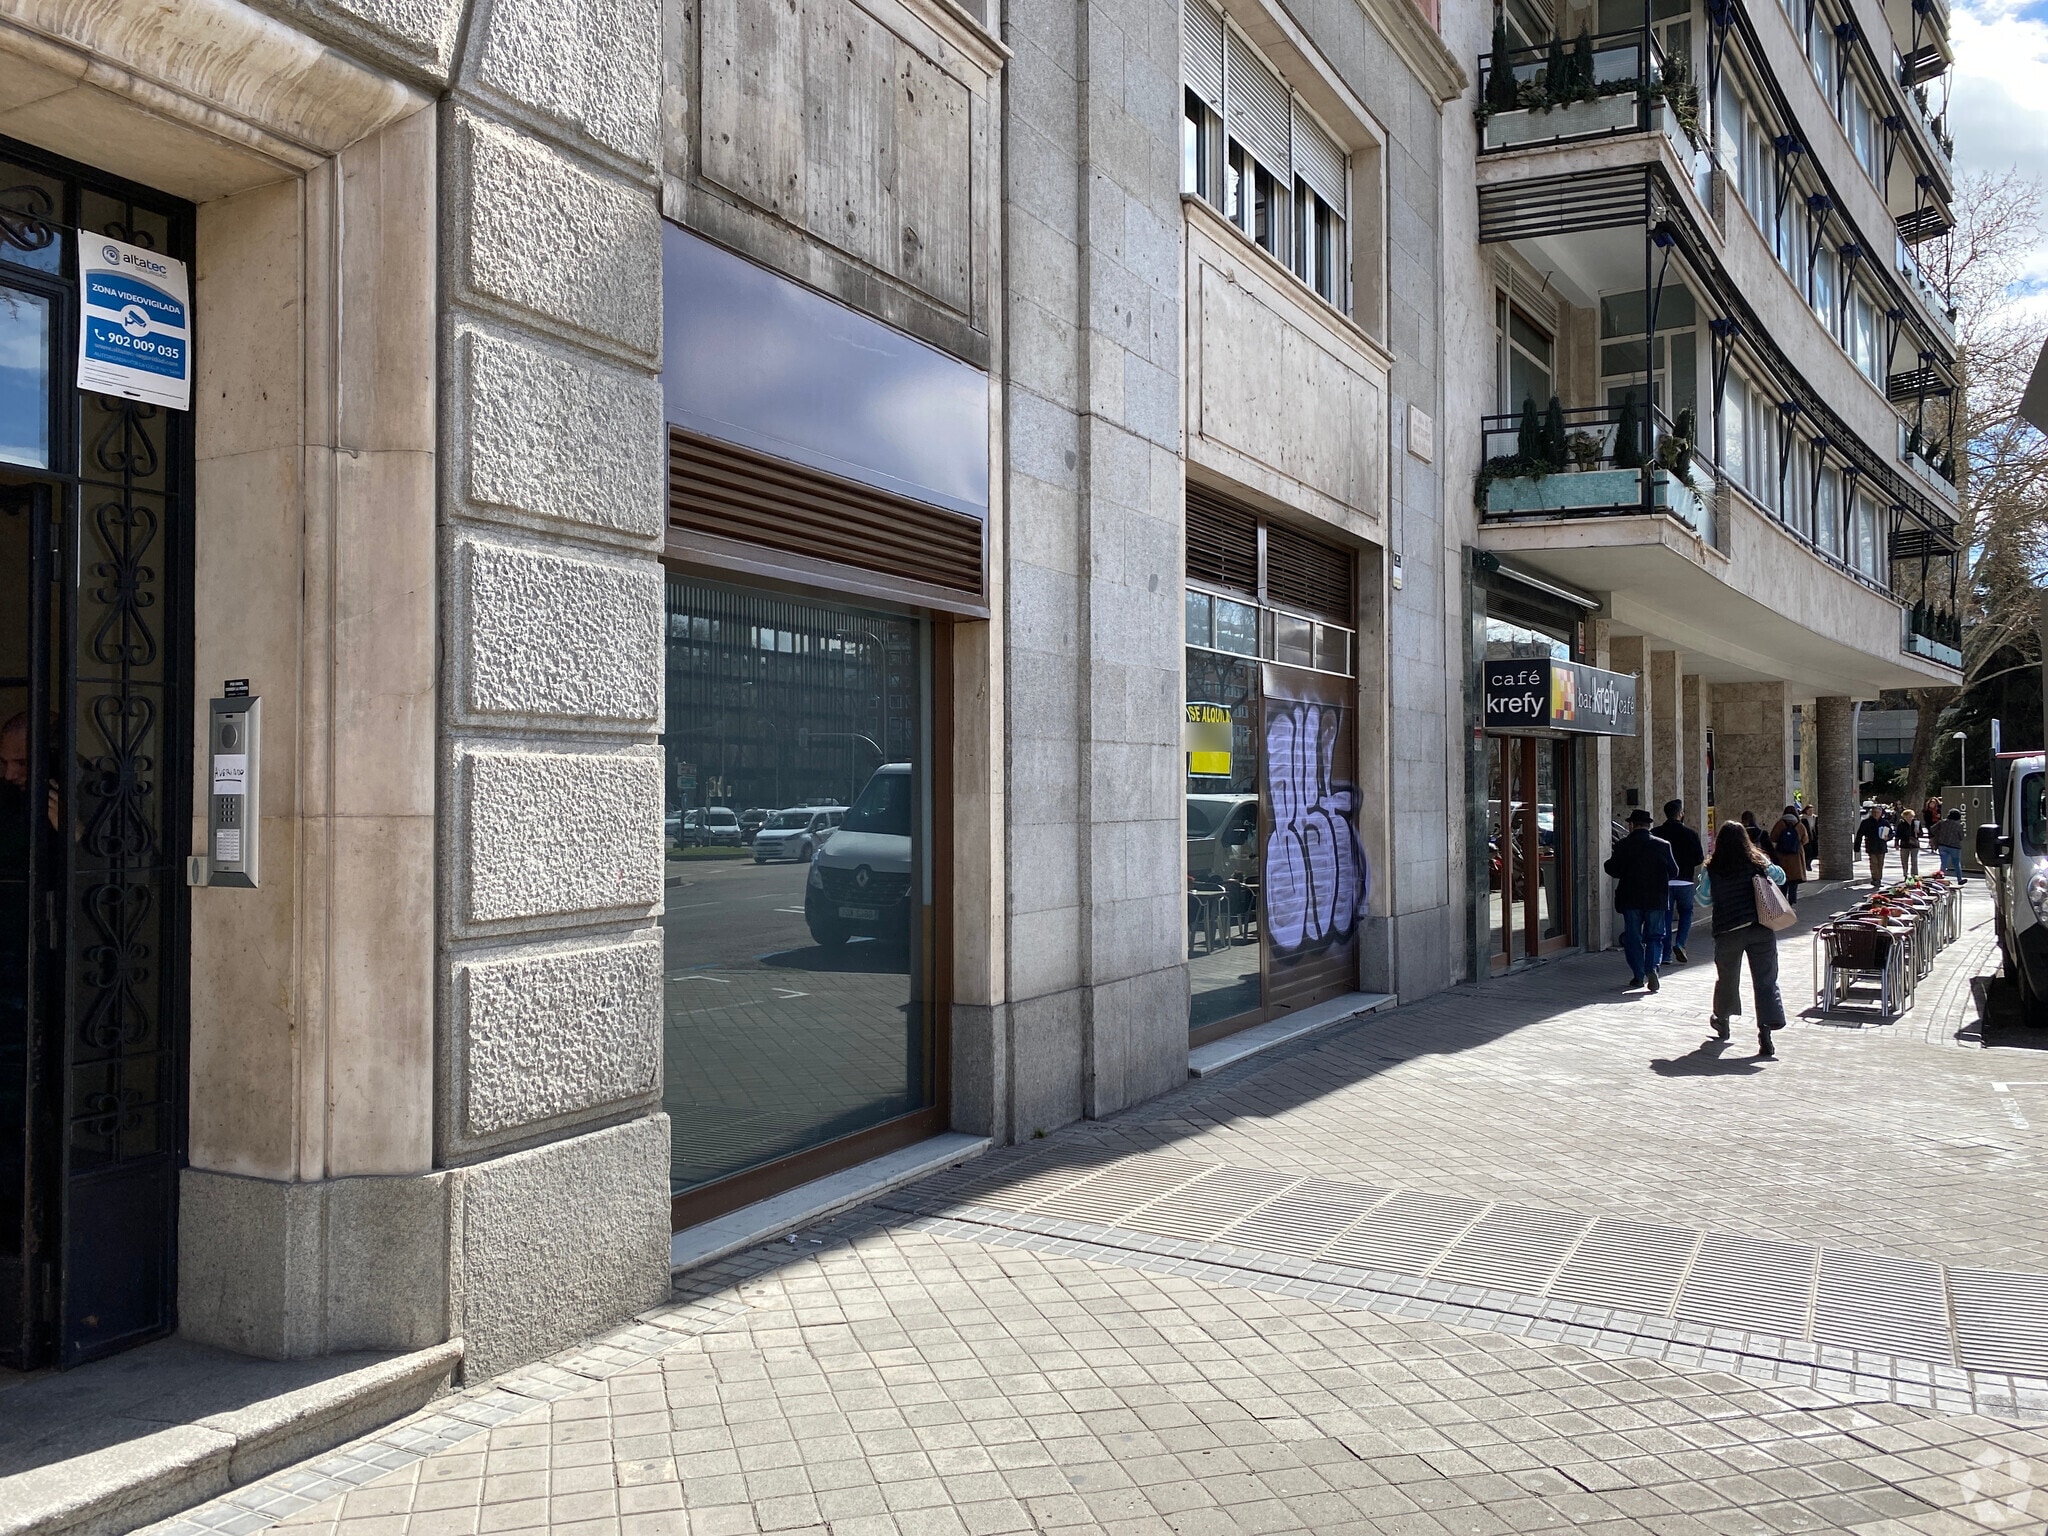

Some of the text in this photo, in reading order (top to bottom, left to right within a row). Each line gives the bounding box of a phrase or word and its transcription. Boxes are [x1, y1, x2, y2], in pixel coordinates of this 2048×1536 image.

[123, 254, 167, 274] altatec
[92, 283, 181, 315] ZONA VIDEOVIGILADA
[108, 332, 180, 360] 902 009 035
[1491, 670, 1541, 686] café
[1187, 705, 1231, 723] SE ALQUILA
[1487, 692, 1545, 718] krefy
[1577, 677, 1635, 726] bar krefy café
